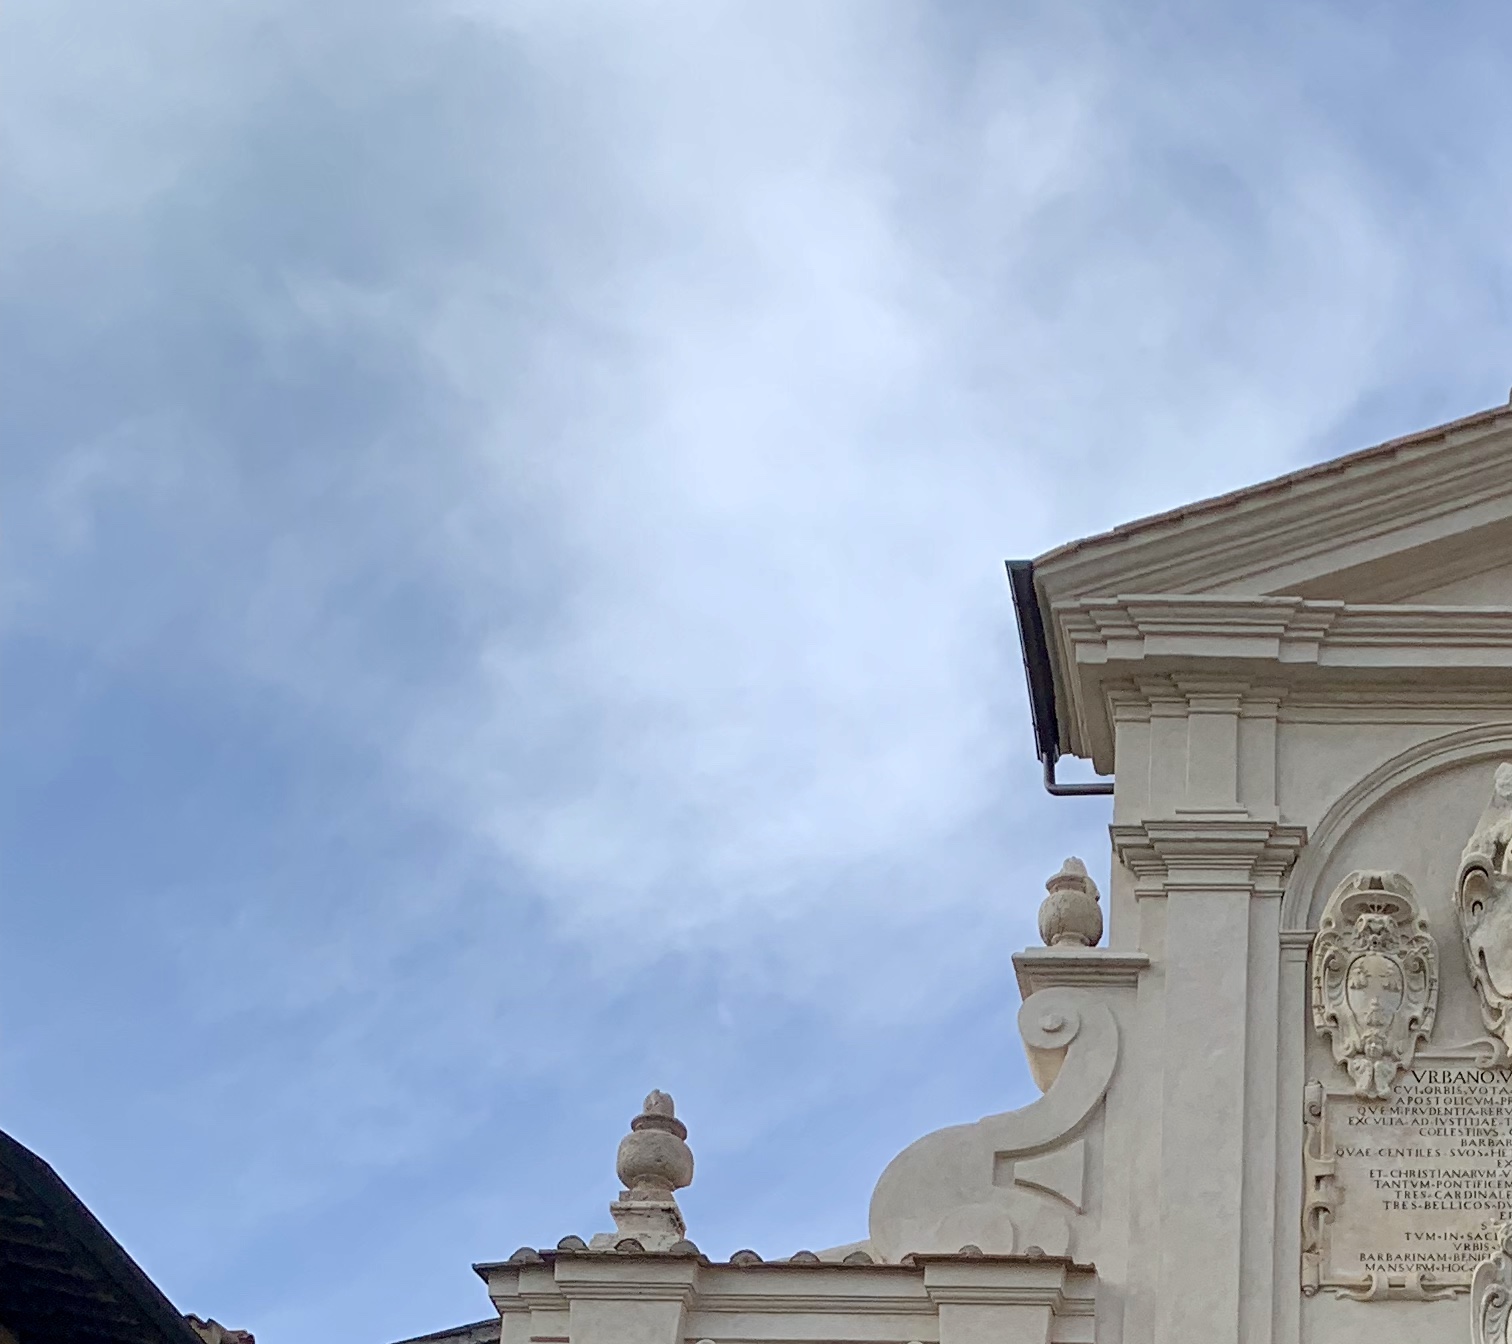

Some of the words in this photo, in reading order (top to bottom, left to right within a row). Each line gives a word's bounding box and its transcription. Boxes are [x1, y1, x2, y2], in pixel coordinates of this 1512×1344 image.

[1398, 1096, 1494, 1106] APOSTOLICVM
[1419, 1128, 1498, 1137] COELESTIBVS
[1450, 1149, 1483, 1158] SVOS
[1369, 1169, 1382, 1179] ET
[1390, 1169, 1496, 1179] CHRISTIANARVM
[1374, 1180, 1430, 1190] TANTVM
[1396, 1190, 1427, 1200] TRES
[1383, 1201, 1418, 1210] TRES
[1424, 1201, 1491, 1210] BELLICOS
[1405, 1232, 1436, 1241] TVM
[1444, 1232, 1458, 1241] IN
[1453, 1243, 1490, 1251] VRBIS
[1359, 1253, 1447, 1262] BARBARINAM
